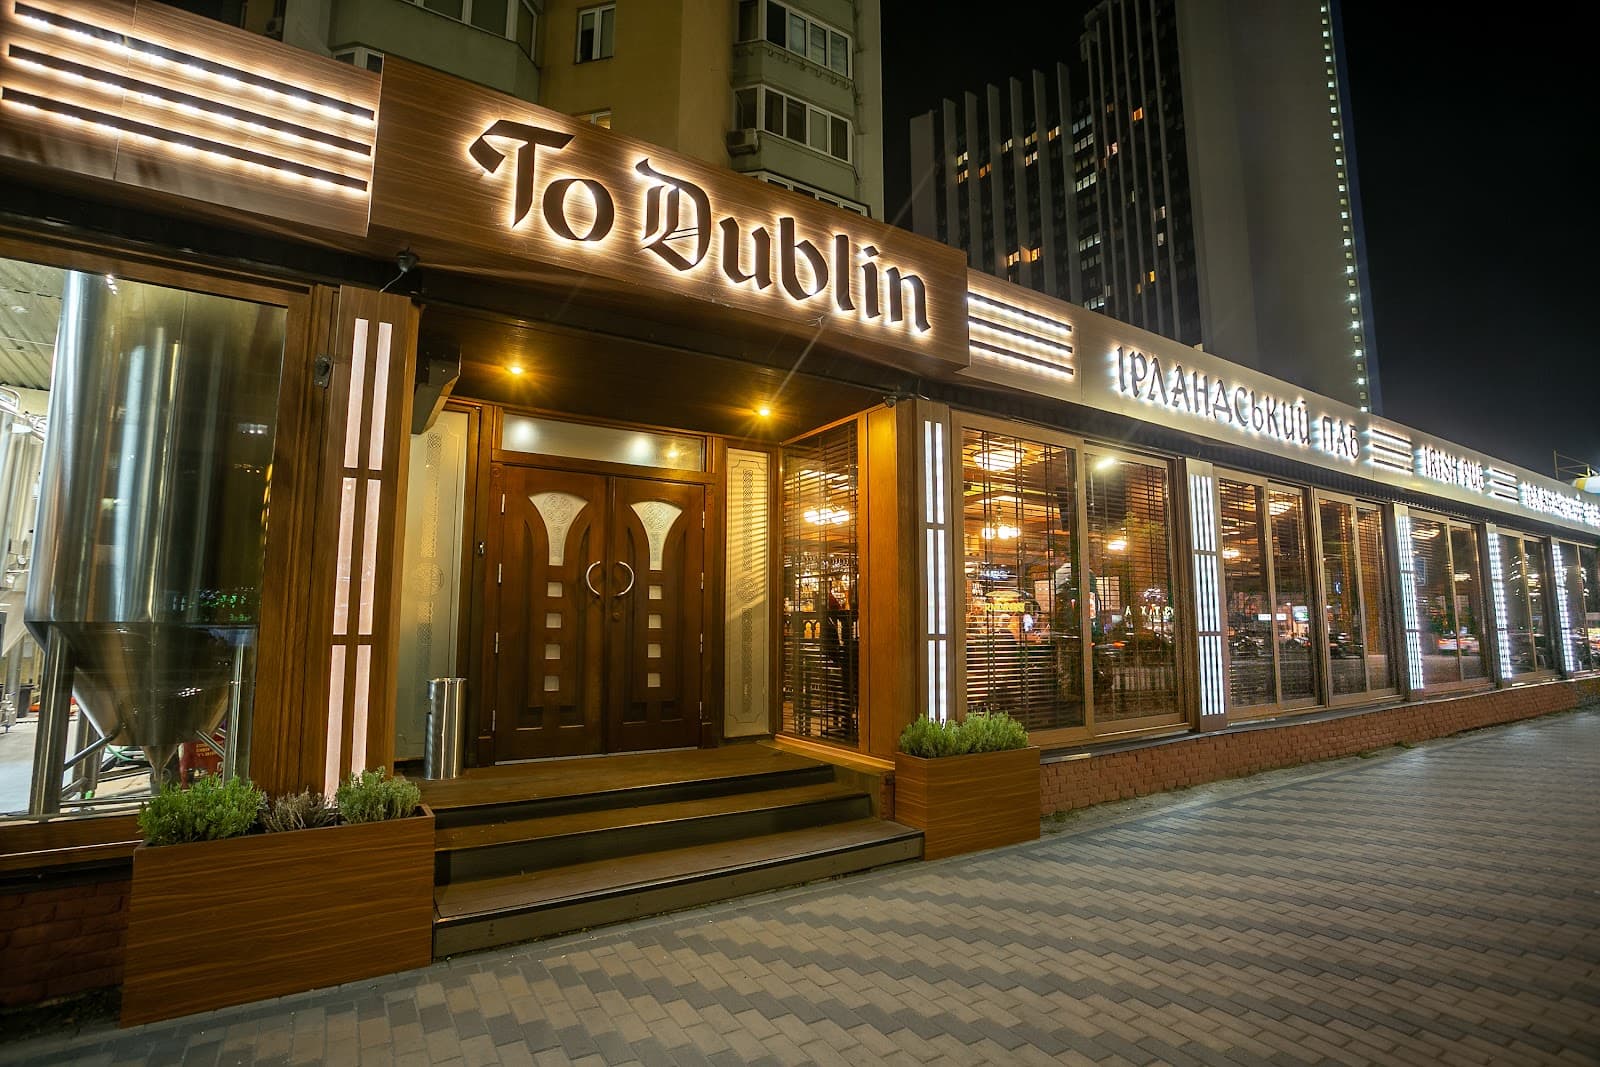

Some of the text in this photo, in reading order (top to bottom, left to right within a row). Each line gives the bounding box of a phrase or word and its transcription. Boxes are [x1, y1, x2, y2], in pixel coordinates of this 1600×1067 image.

[468, 119, 932, 333] To Dublin
[1117, 345, 1360, 459] ІРЛАНДСЬКИЙ ПАБ
[1423, 444, 1459, 485] IRISH
